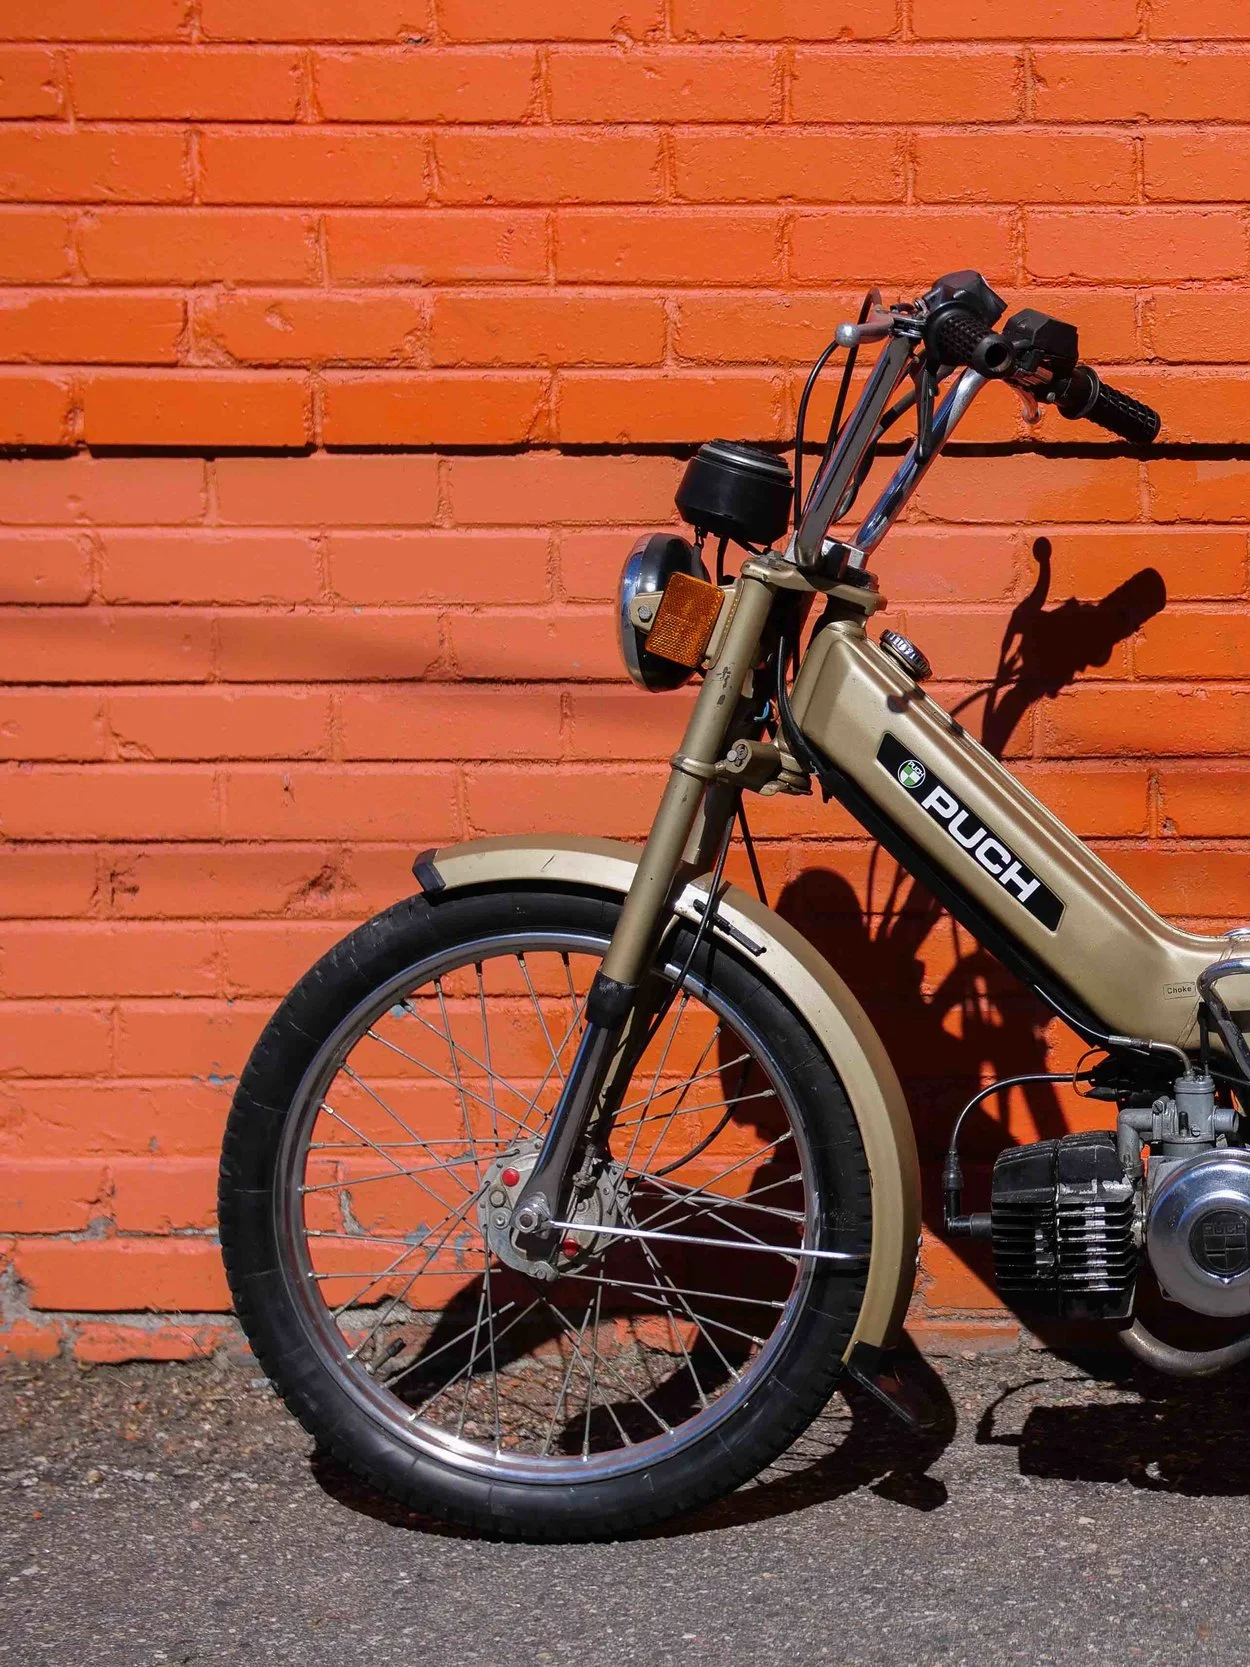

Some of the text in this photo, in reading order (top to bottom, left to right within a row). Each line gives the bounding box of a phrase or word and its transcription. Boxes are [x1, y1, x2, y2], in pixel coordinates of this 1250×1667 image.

[908, 761, 925, 778] PUCH
[921, 785, 1041, 902] PUCH
[1167, 986, 1192, 995] Choke
